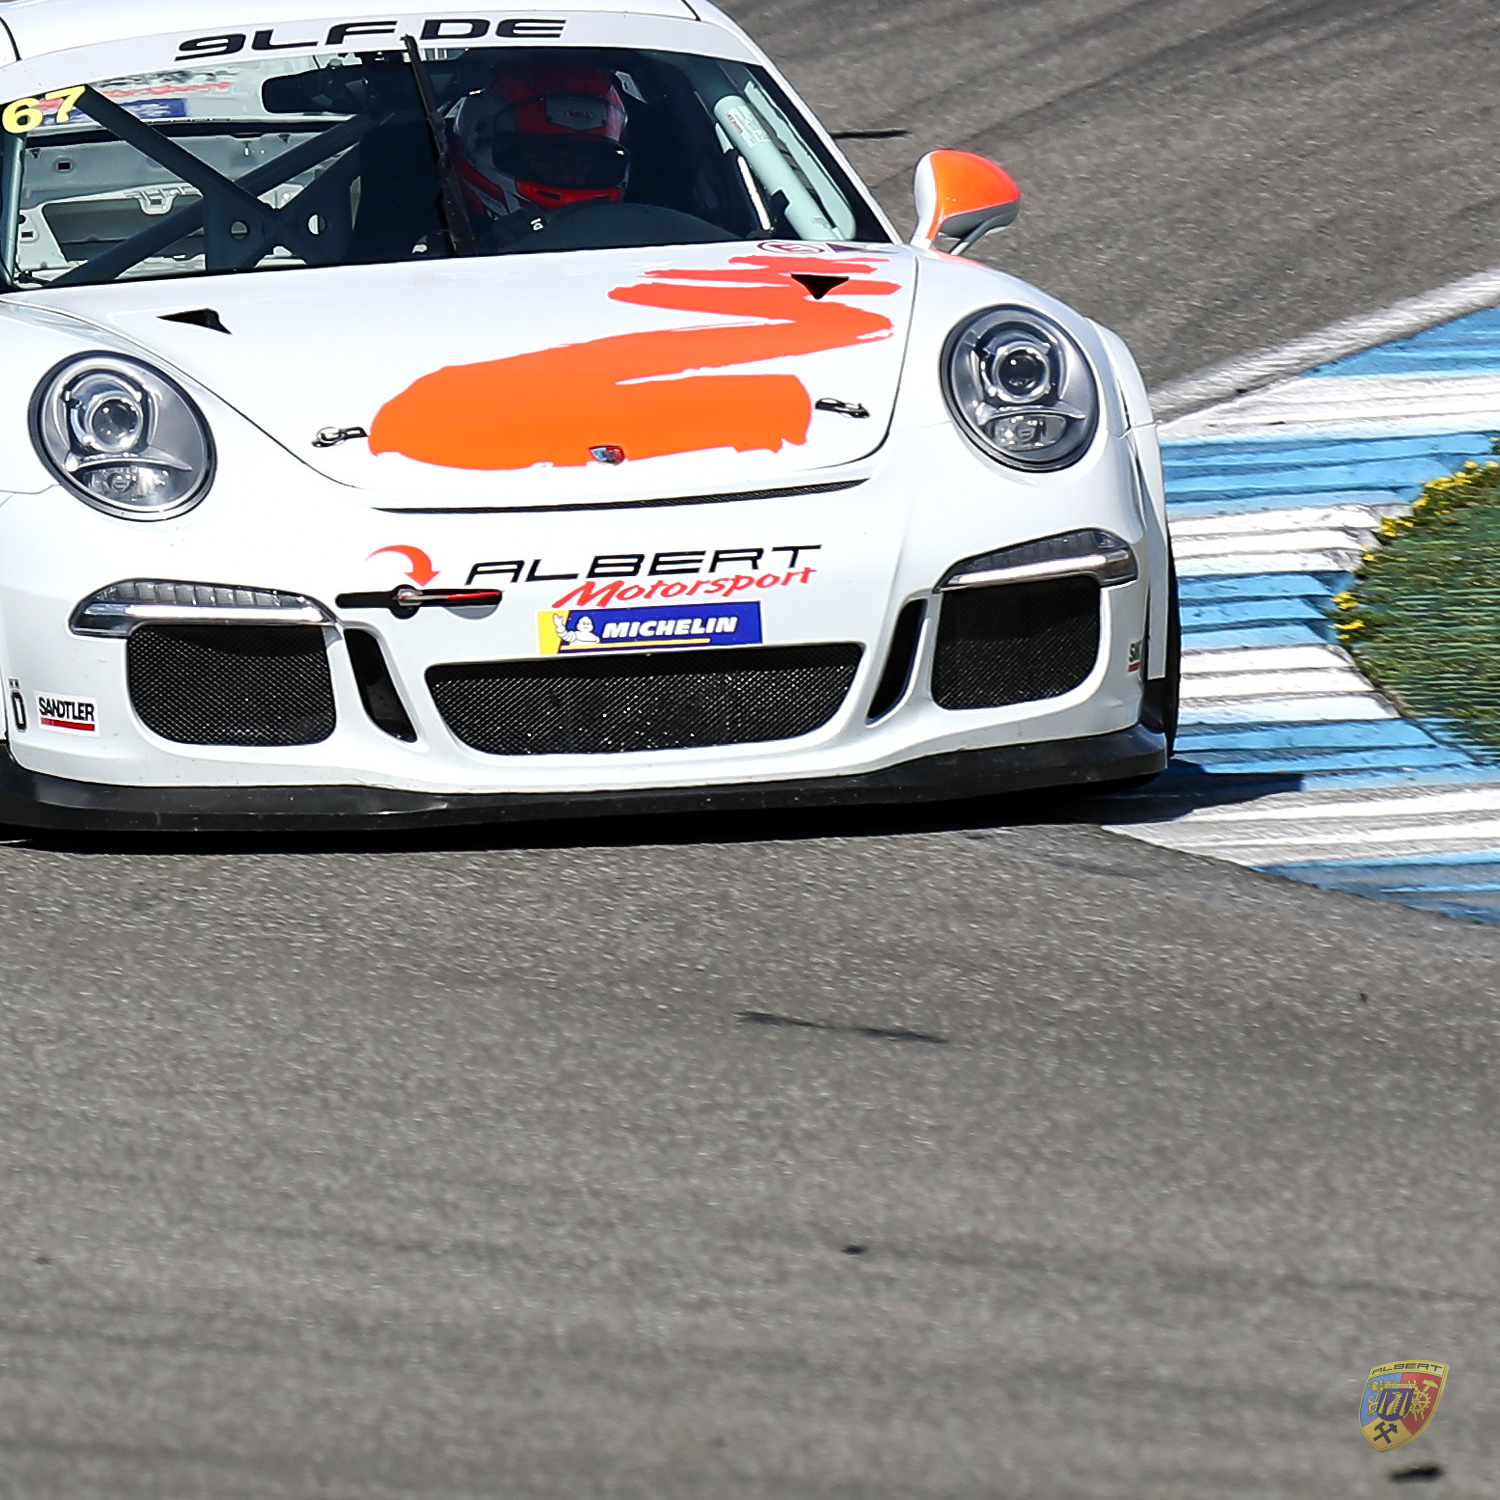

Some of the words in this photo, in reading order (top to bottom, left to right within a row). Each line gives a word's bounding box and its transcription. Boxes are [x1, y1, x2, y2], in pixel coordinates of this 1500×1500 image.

[1, 85, 86, 134] 67
[466, 545, 821, 585] ALBERT
[551, 566, 817, 609] Motorsport
[602, 616, 738, 640] MICHELIN
[39, 696, 95, 722] SANDTLER
